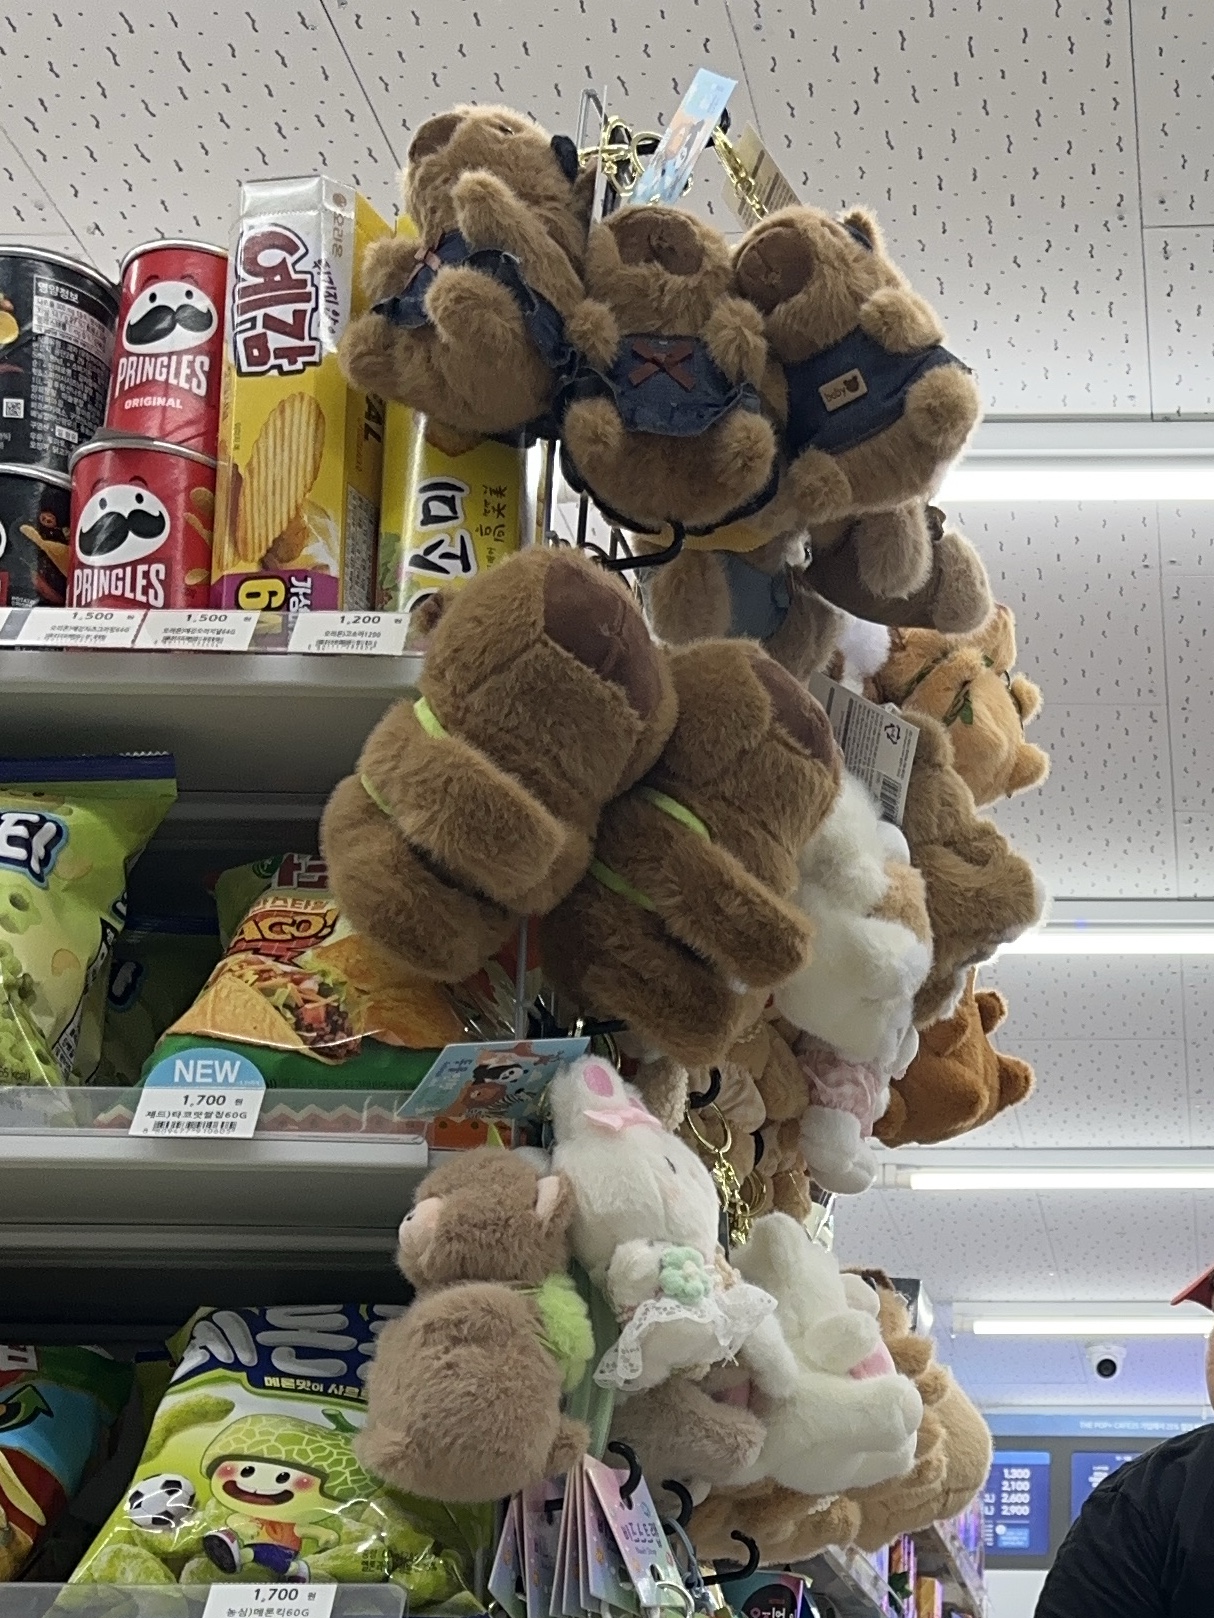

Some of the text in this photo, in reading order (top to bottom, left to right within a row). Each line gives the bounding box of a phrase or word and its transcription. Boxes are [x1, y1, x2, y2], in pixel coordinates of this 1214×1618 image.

[235, 226, 320, 376] 예감
[115, 353, 210, 399] PRINGLES
[124, 395, 183, 411] ORIGINAL
[408, 481, 472, 613] 소미
[73, 563, 166, 608] PRINGLES
[72, 611, 114, 621] 1,500
[186, 613, 228, 623] 1,500
[340, 615, 381, 625] 1,200
[238, 907, 340, 942] ACO!
[174, 1060, 241, 1083] NEW
[182, 1094, 227, 1106] 1,700
[253, 1588, 299, 1602] 1,700
